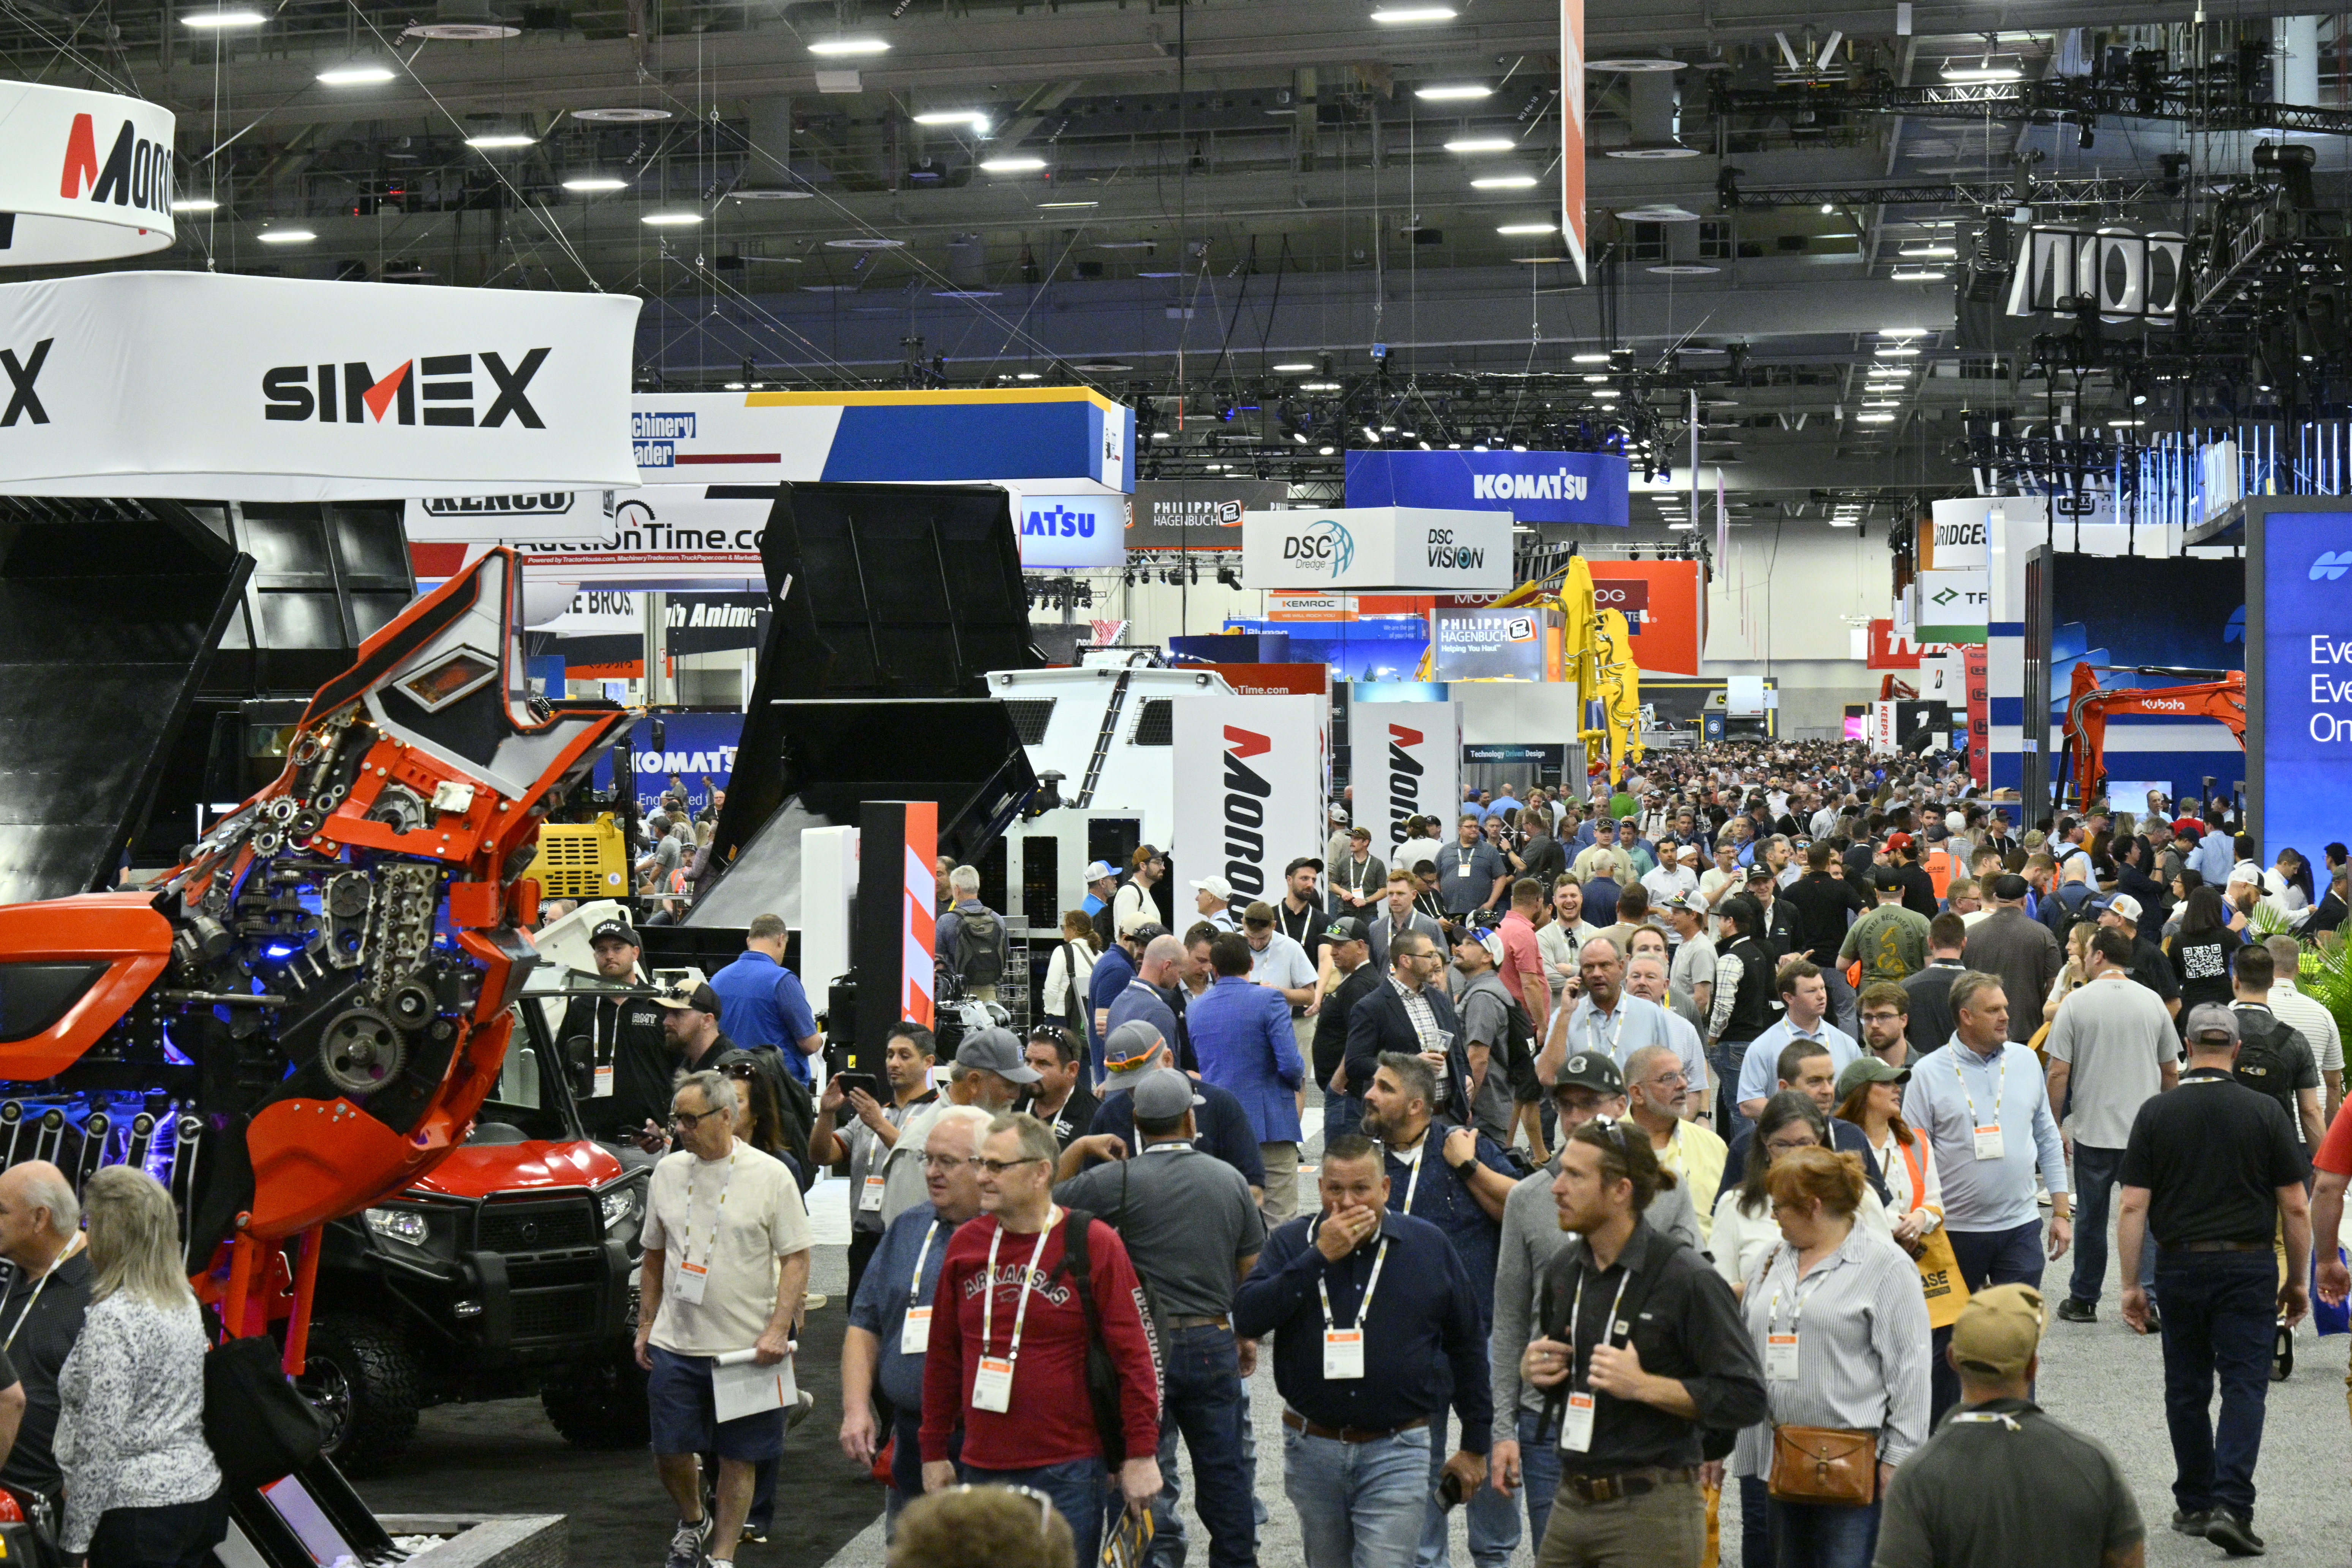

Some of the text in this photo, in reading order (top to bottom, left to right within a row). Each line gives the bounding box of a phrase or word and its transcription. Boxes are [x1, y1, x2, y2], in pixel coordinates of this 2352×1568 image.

[893, 6, 904, 17] W3
[394, 35, 405, 46] W3
[1517, 96, 1539, 121] W3 R6-10
[626, 155, 635, 165] W3
[263, 348, 552, 429] SIMEX
[1474, 467, 1587, 500] KOMATSU
[1154, 515, 1218, 526] HAGENBUCH
[1428, 529, 1453, 544] DSC
[1283, 536, 1332, 559] DSC
[1428, 546, 1484, 569] VISION
[1296, 559, 1325, 570] Dredge
[1441, 618, 1507, 630] PHILIPPI
[1441, 631, 1508, 642] HAGENBUCH
[2142, 698, 2185, 710] Kubota
[1470, 750, 1504, 759] Technology
[1525, 749, 1545, 758] Design
[1881, 914, 1909, 929] BECAUSE
[632, 1013, 657, 1024] RMT
